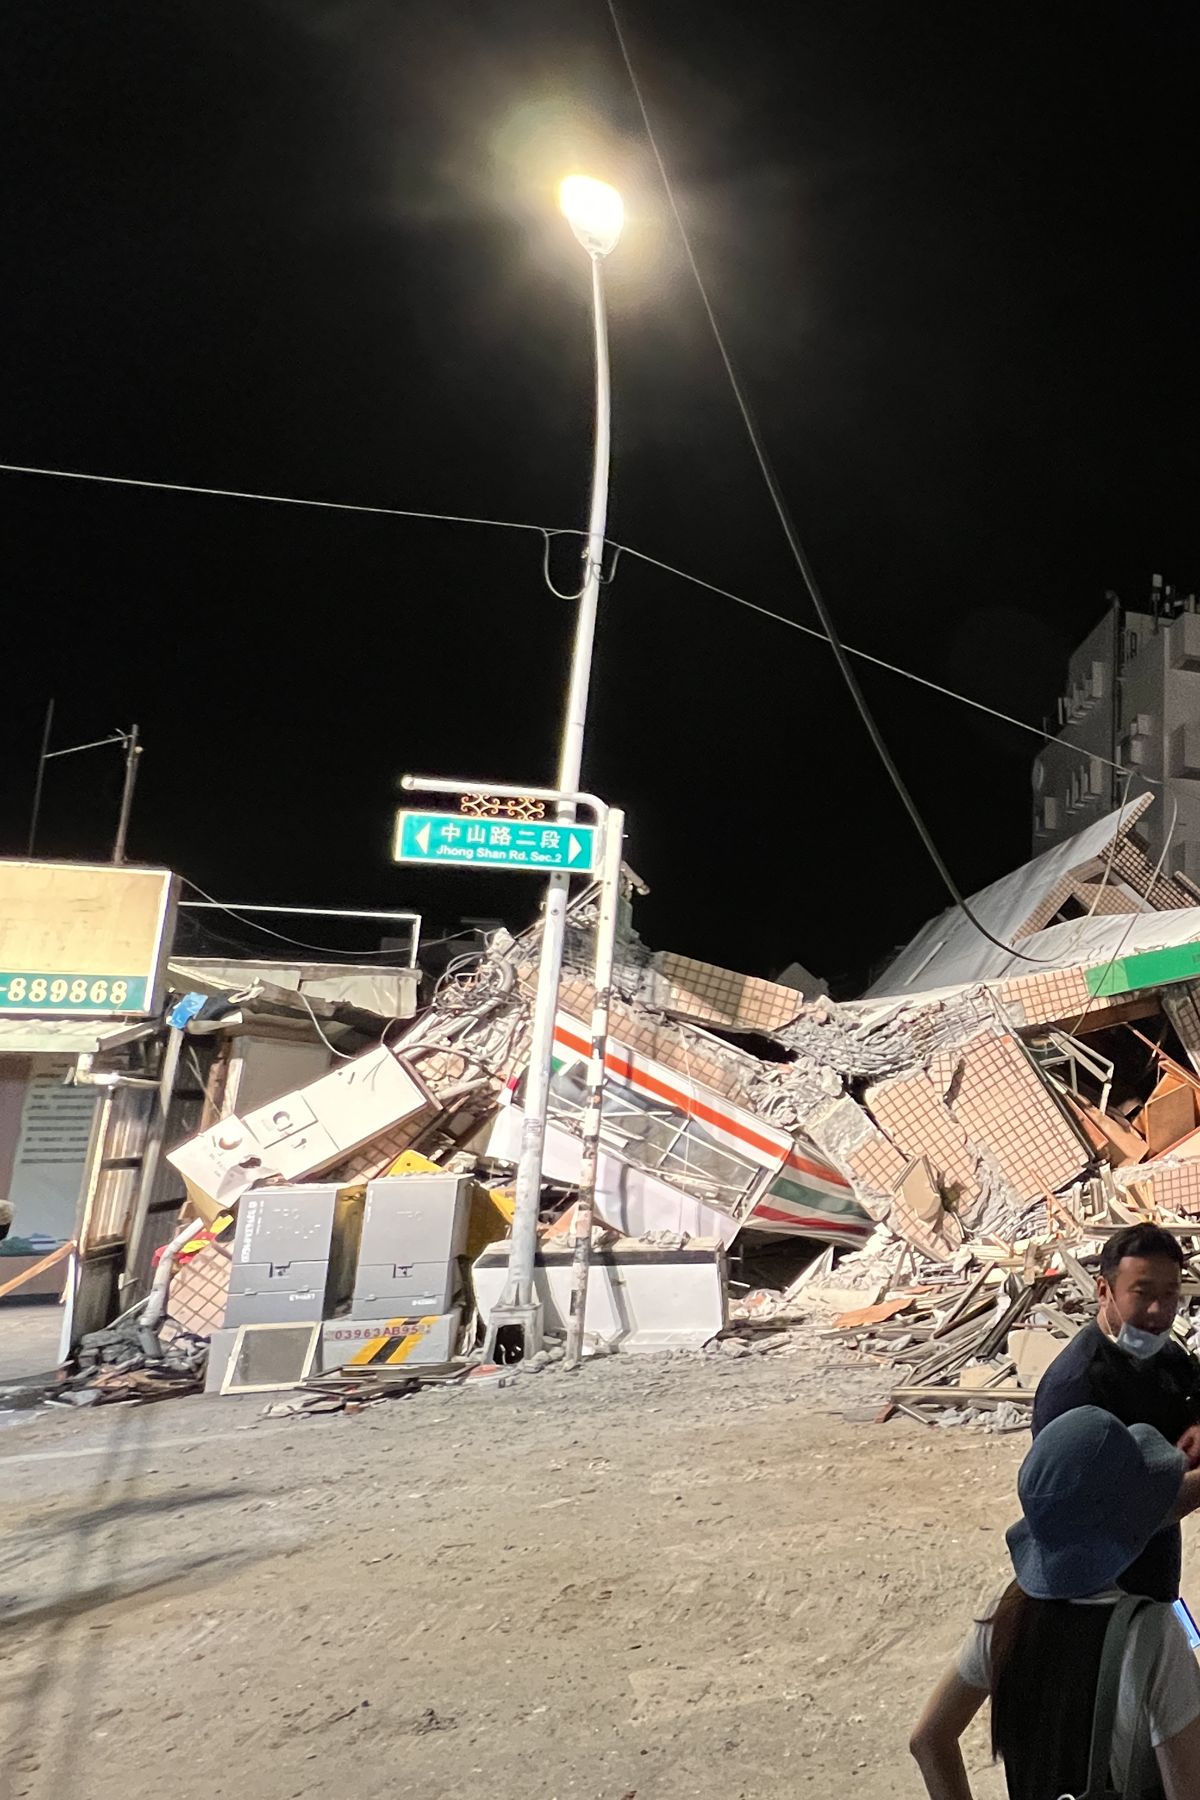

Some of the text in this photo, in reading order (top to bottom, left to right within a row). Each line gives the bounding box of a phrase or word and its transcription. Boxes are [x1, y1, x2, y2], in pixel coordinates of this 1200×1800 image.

[440, 822, 561, 849] 中山路二段
[436, 845, 562, 863] Jhong Shan Rd. Sec.2
